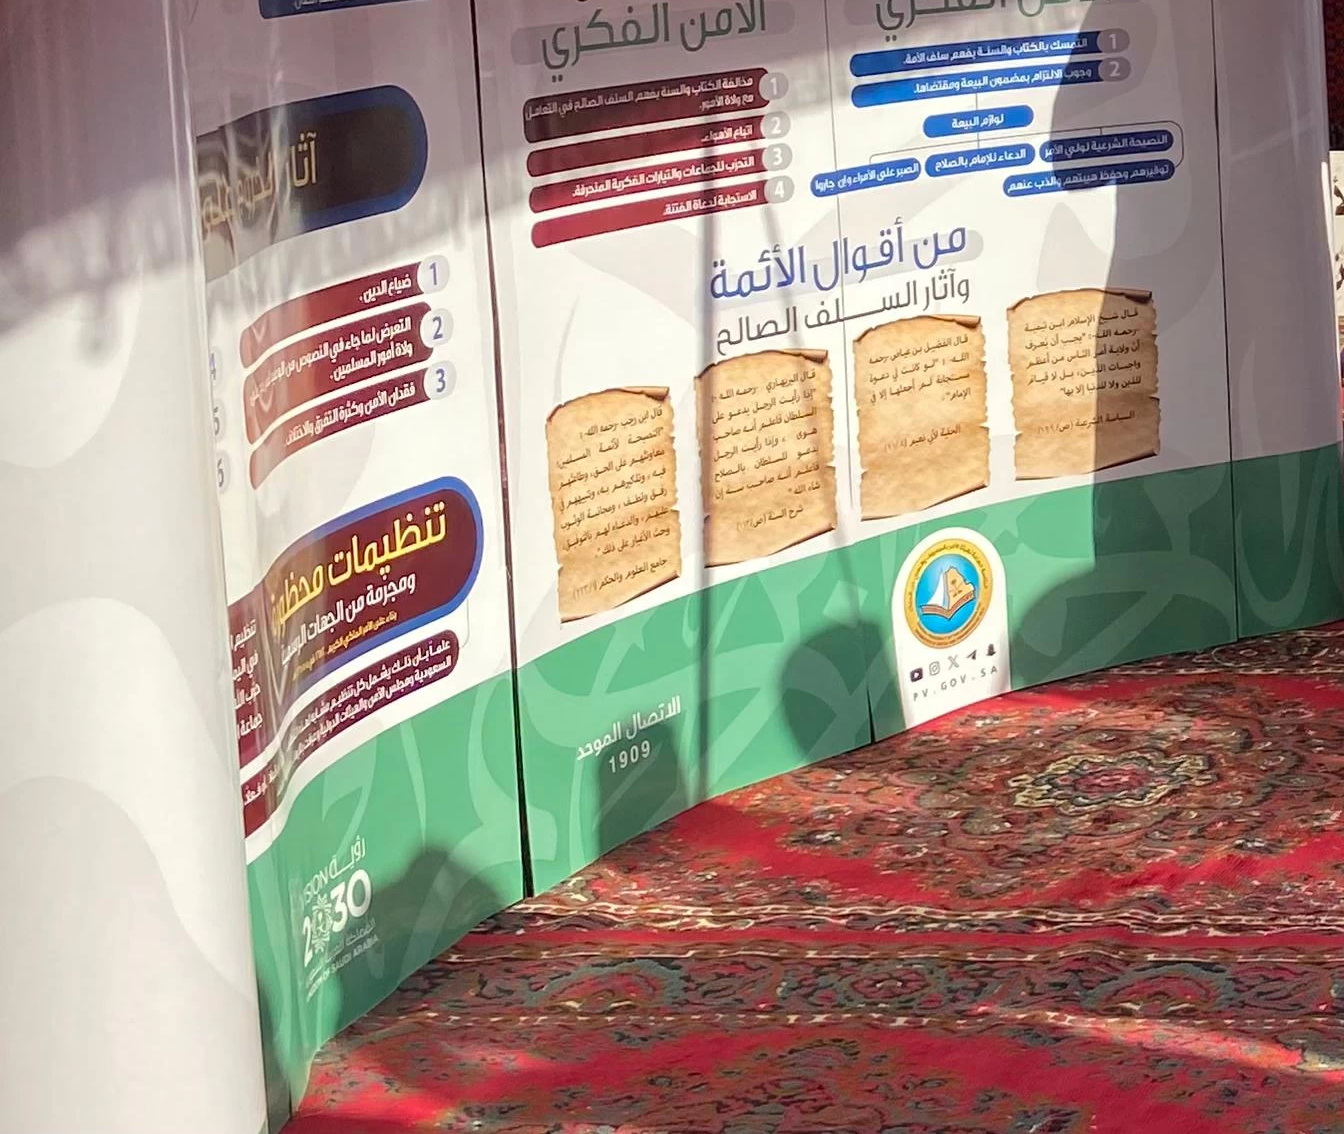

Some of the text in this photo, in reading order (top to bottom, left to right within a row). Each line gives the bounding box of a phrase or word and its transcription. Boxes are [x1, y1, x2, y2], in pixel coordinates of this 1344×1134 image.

[542, 1, 670, 83] الفكري
[1109, 34, 1116, 48] 1
[1110, 61, 1119, 76] 2
[770, 79, 778, 95] 1
[771, 117, 781, 134] 2
[773, 149, 782, 166] 3
[774, 181, 784, 198] 4
[709, 215, 967, 298] من أقوال الأئمة
[428, 262, 439, 286] 1
[717, 268, 970, 356] وآثار السلف الصالح
[431, 316, 444, 341] 2
[434, 368, 447, 393] 3
[328, 501, 447, 585] تنظيمات
[576, 694, 682, 763] الاتصال الموحد
[609, 742, 651, 772] 1909
